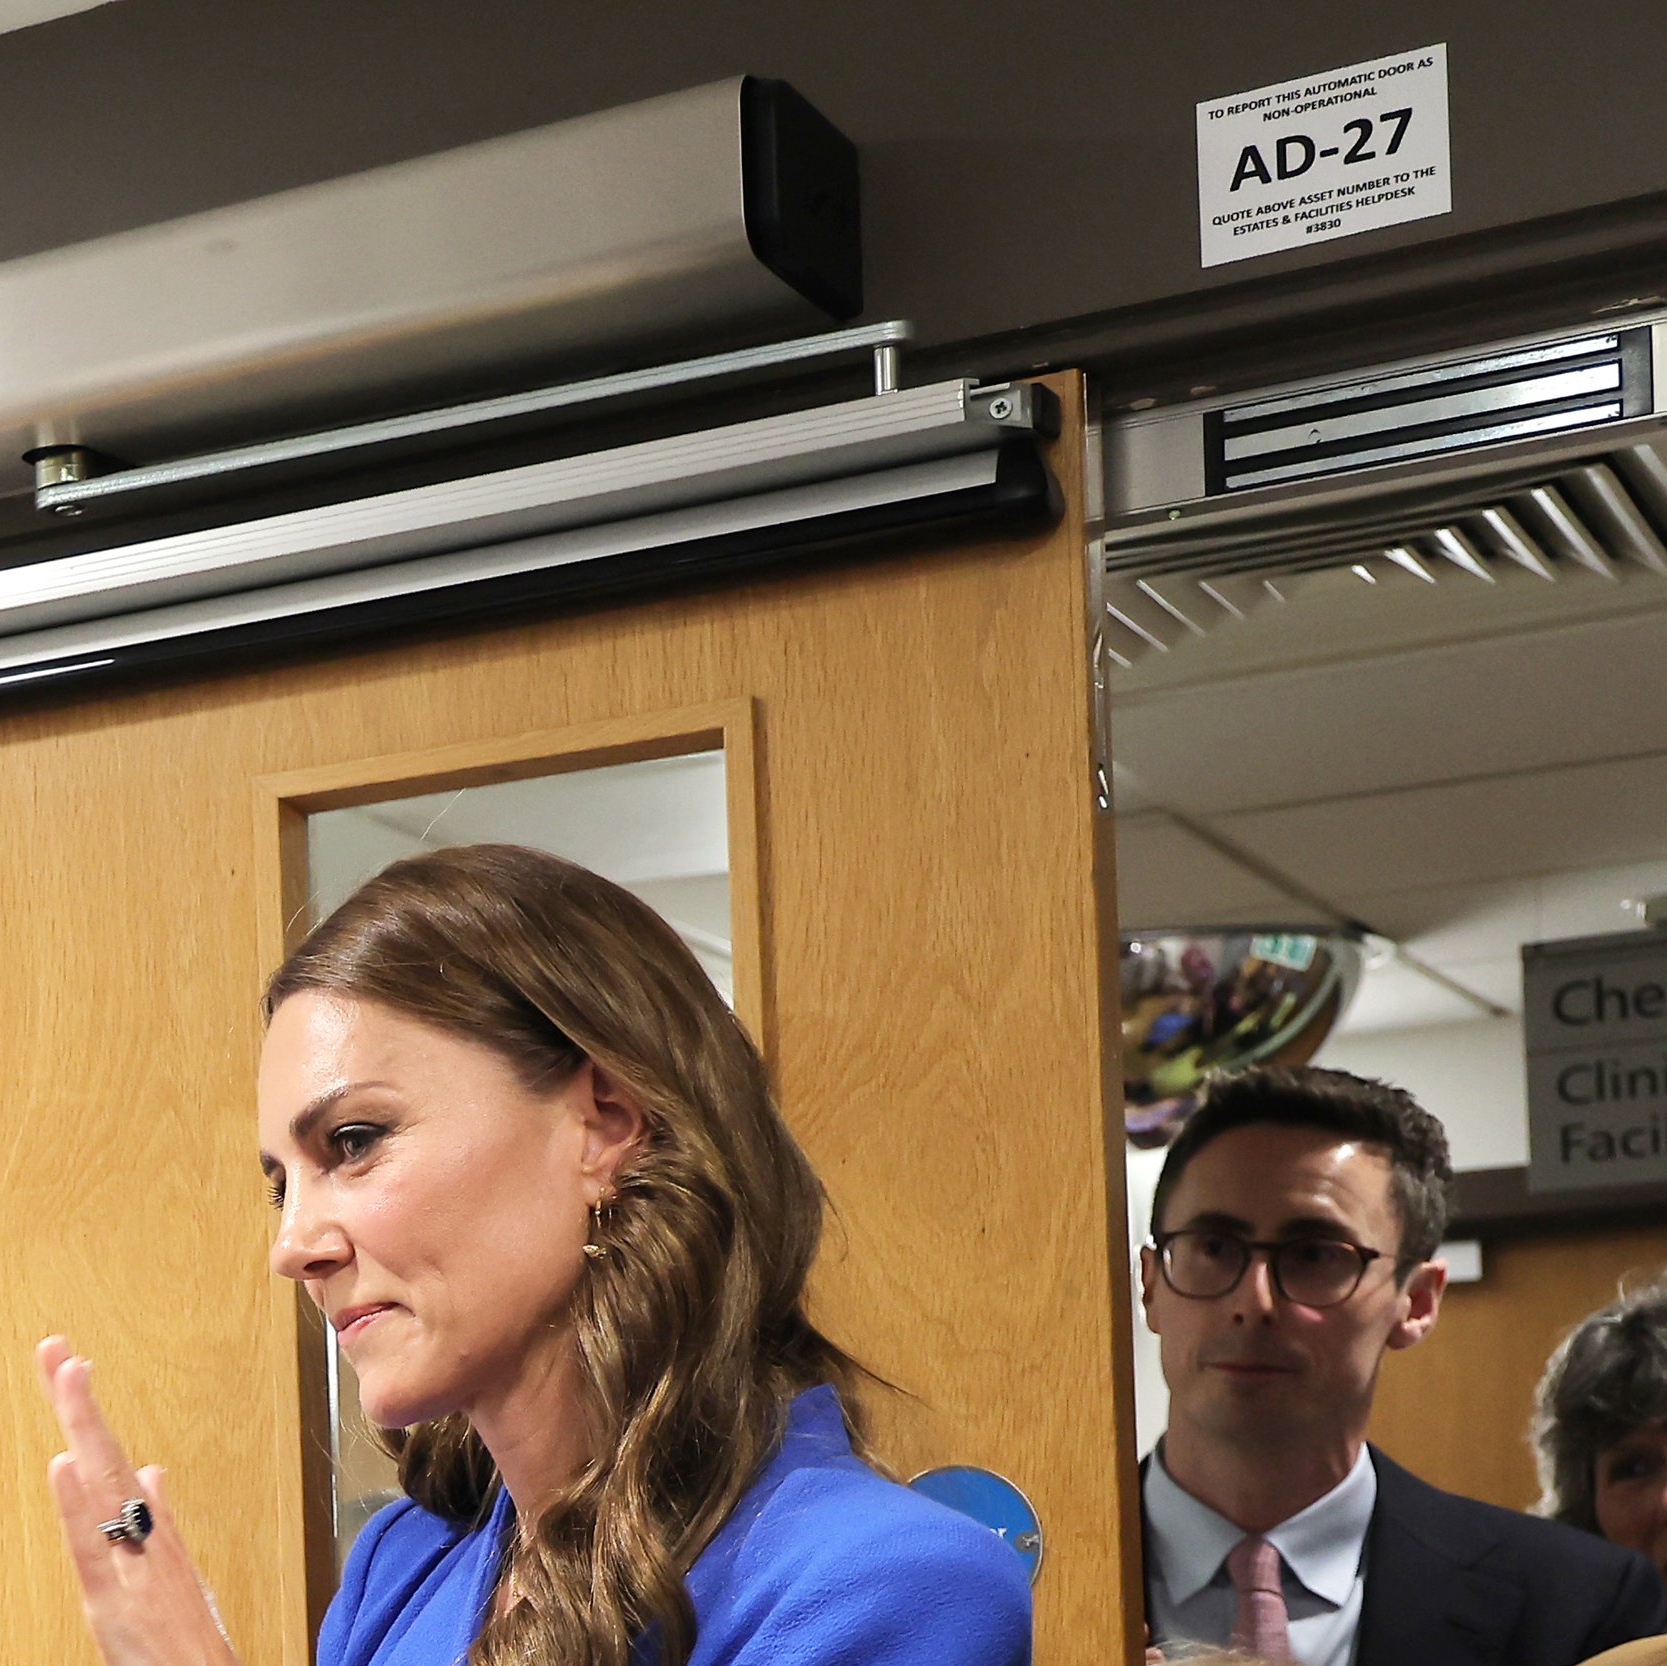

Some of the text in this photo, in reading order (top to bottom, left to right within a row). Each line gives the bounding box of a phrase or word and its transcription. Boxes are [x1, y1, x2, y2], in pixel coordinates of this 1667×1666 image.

[1208, 56, 1433, 120] TO REPORT THIS AUTOMATIC DOOR AS
[1263, 86, 1377, 122] NON-OPERATIONAL
[1229, 107, 1413, 192] AD-27
[1212, 166, 1437, 226] QUOTE ABOVE ASSET NUMBER TO THE
[1233, 186, 1416, 236] ESTATES & FACILITIES HELPDESK
[1306, 218, 1341, 235] #3830
[1561, 1111, 1667, 1163] Faci
